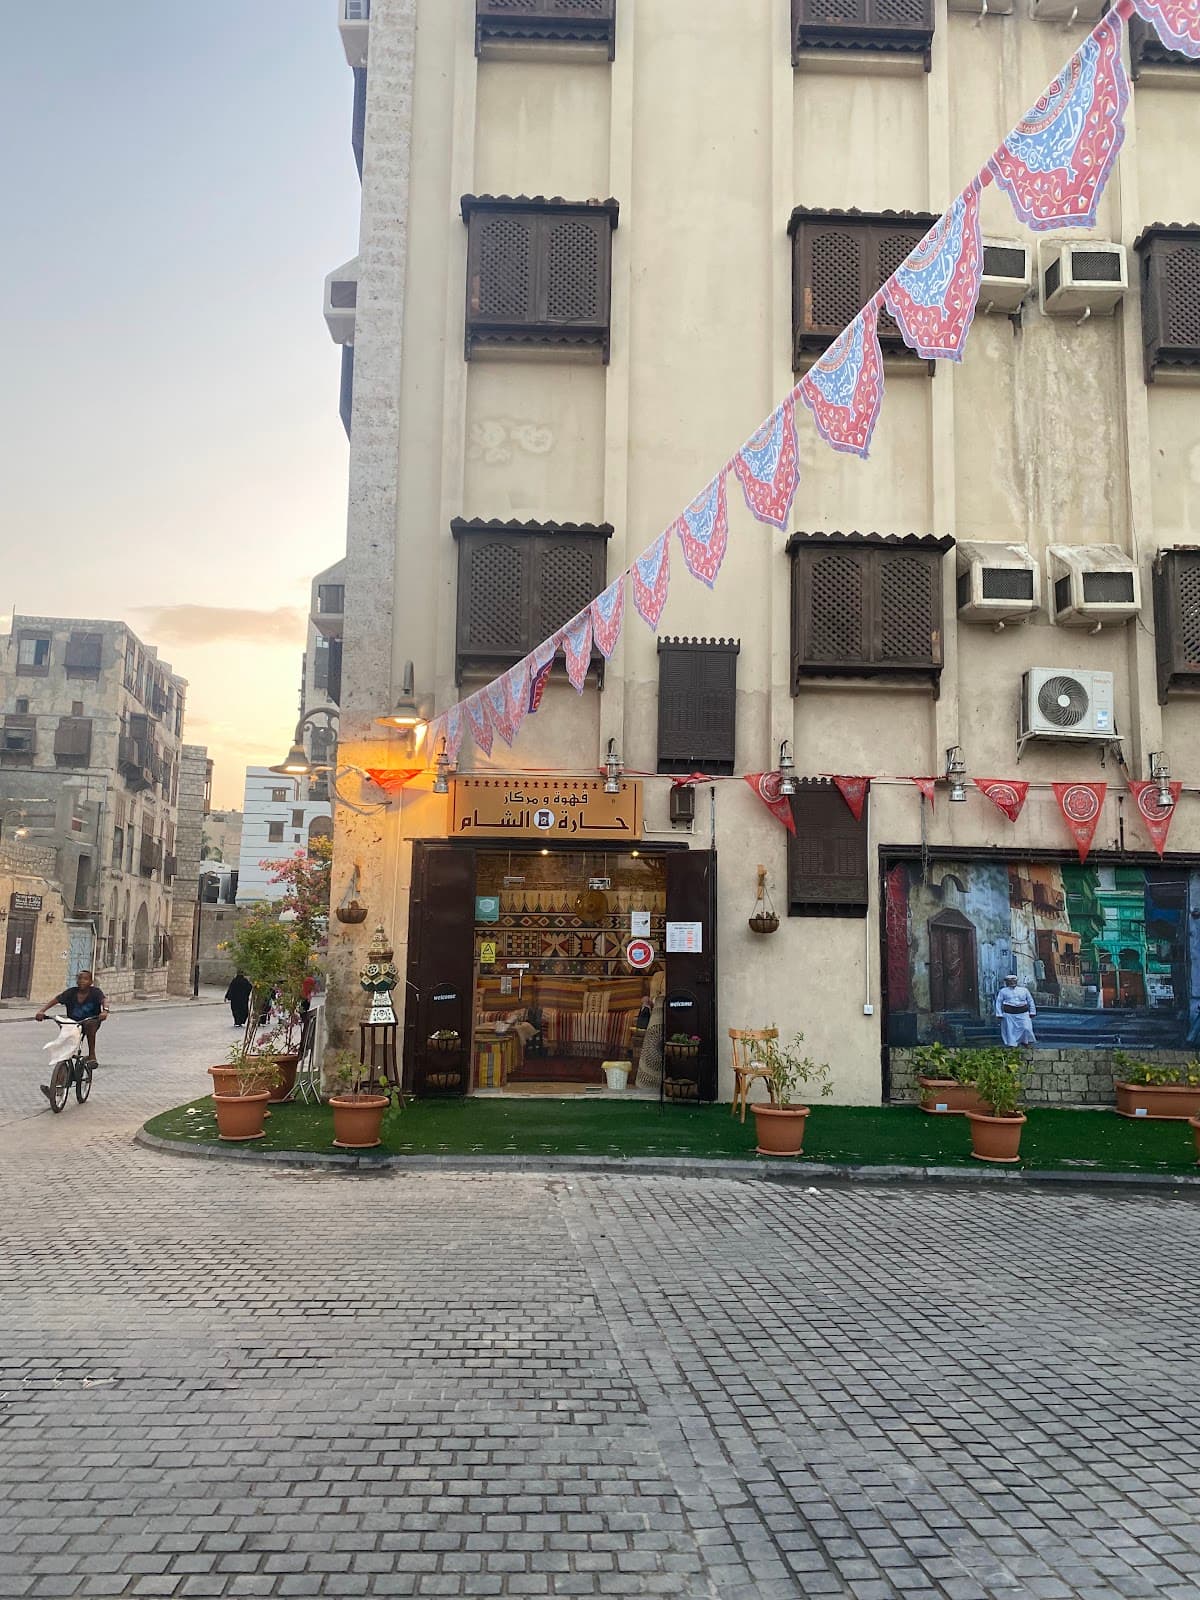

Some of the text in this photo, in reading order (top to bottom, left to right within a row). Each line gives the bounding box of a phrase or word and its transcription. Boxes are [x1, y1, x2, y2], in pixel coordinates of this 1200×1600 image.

[503, 791, 588, 807] قهوة و مركاز
[459, 809, 630, 833] حارة الشام
